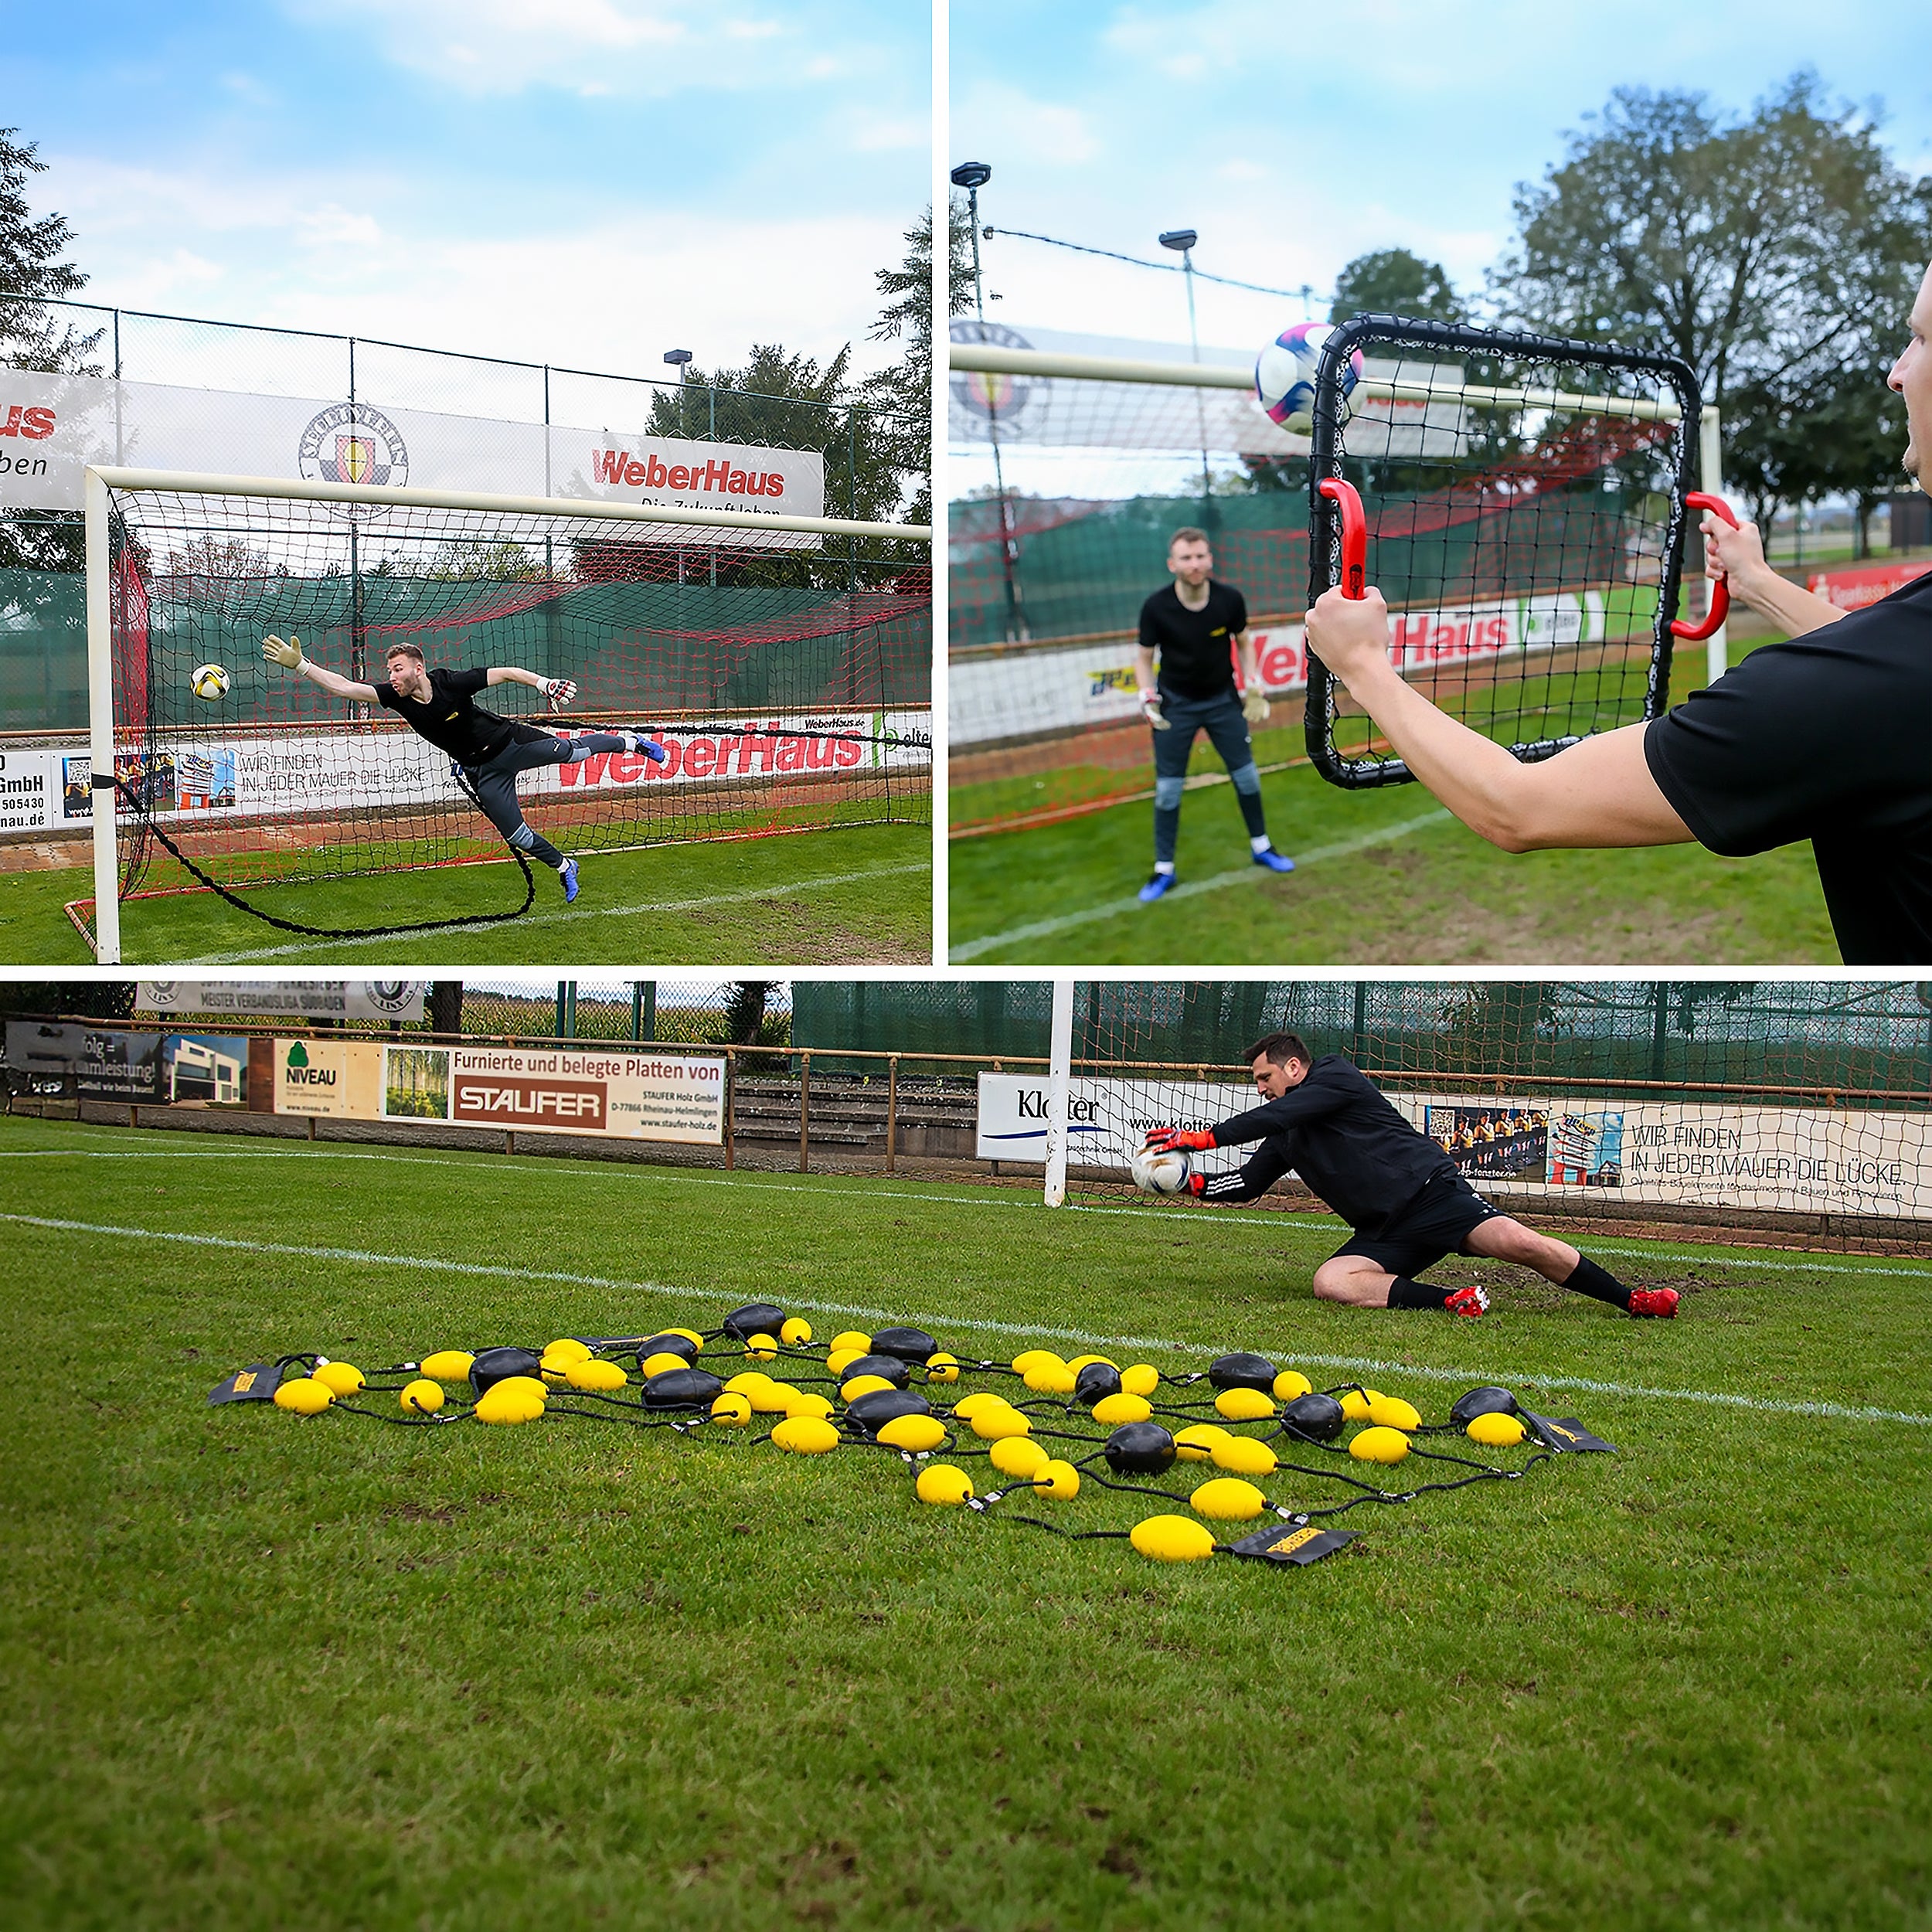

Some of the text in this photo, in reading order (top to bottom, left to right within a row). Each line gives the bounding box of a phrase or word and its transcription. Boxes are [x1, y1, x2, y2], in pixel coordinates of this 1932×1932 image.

[592, 449, 785, 497] WeberHaus
[241, 753, 322, 773] WIR FINDEN
[242, 777, 256, 792] IN
[260, 773, 304, 791] JEDER
[309, 771, 356, 788] MAUER
[361, 770, 380, 785] DIE
[286, 1068, 336, 1086] NIVEAU
[454, 1052, 719, 1080] Furnierte und belegte Platten von
[460, 1086, 600, 1117] STAUFER
[643, 1090, 718, 1104] STAUFER Holz GmbH
[1017, 1090, 1100, 1121] Klter
[641, 1119, 717, 1131] www.staufer-holz.de
[1631, 1124, 1741, 1149] WIR FINDEN
[1631, 1151, 1906, 1185] IN JEDER MAUER DIE LÜCKE.
